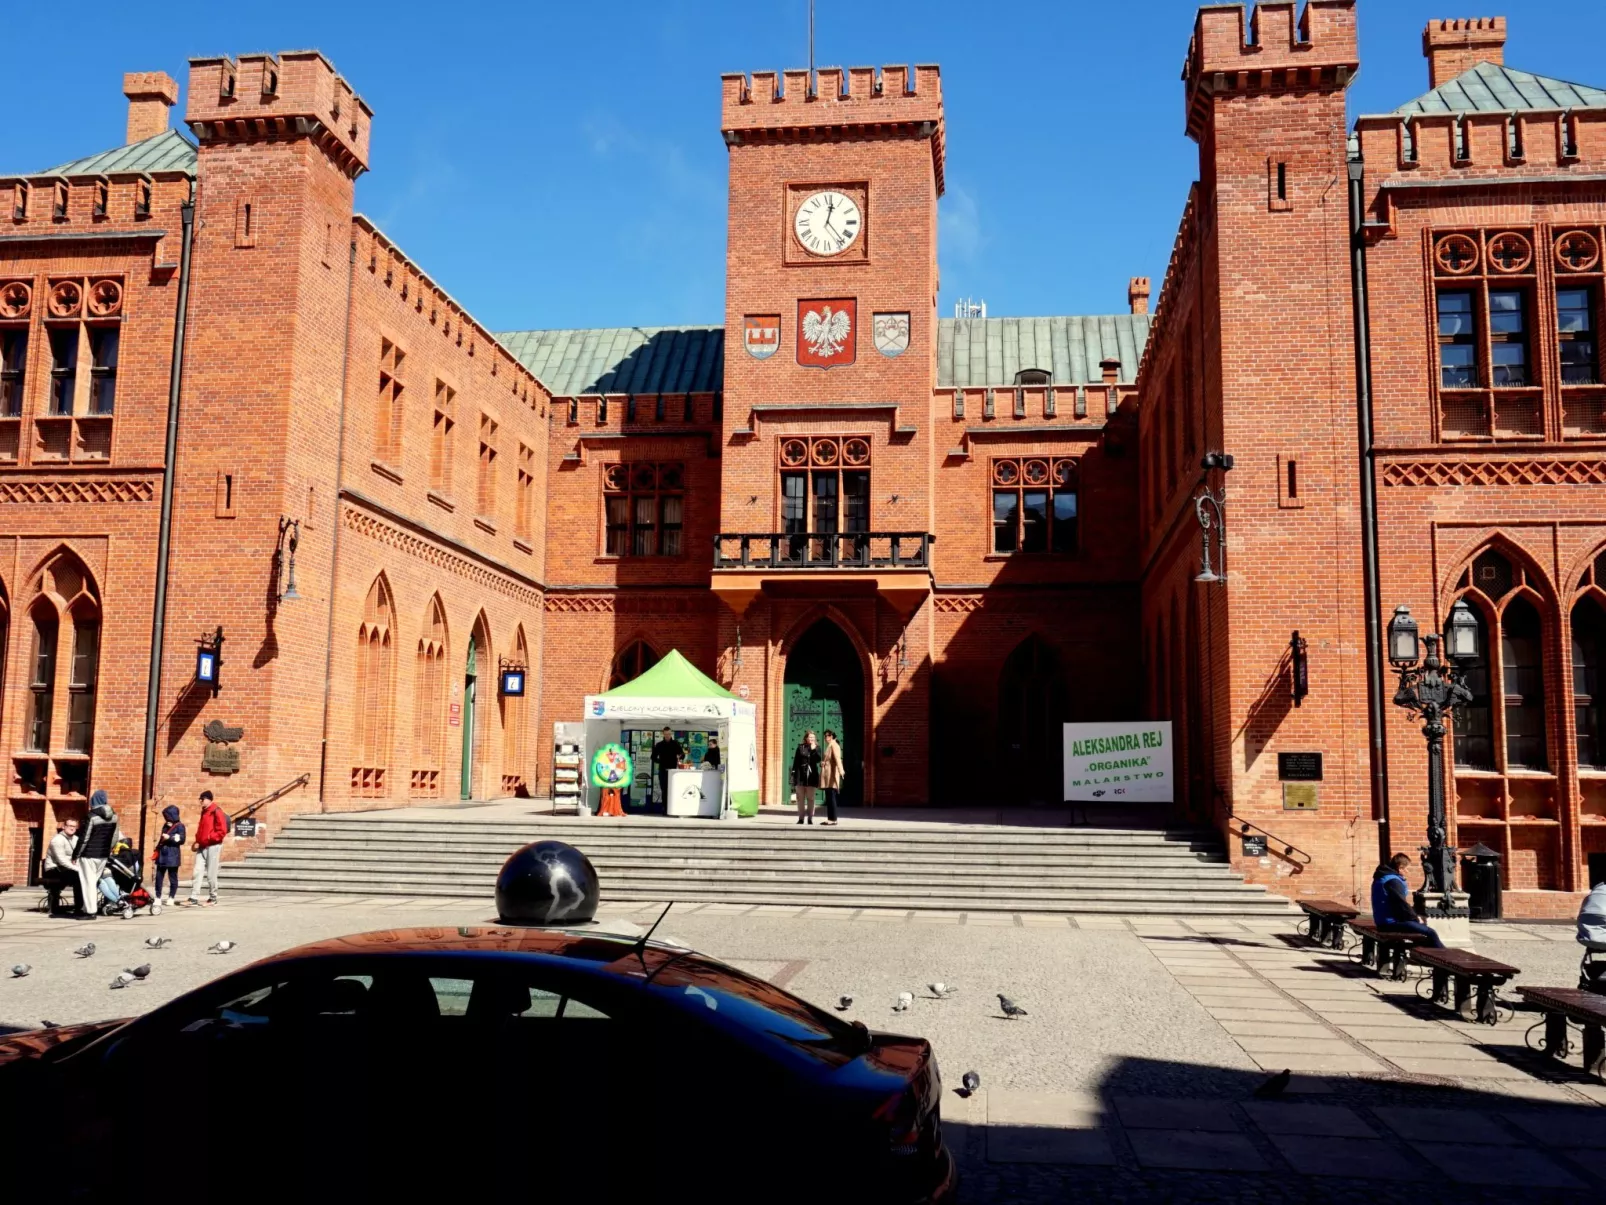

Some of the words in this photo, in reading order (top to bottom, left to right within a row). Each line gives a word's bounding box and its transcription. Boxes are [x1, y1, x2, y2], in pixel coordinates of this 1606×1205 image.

[610, 706, 645, 714] ZIELONY
[1072, 734, 1140, 756] ALEKSANDRA
[1142, 730, 1162, 748] REJ
[1072, 772, 1164, 786] MALARSTWO
